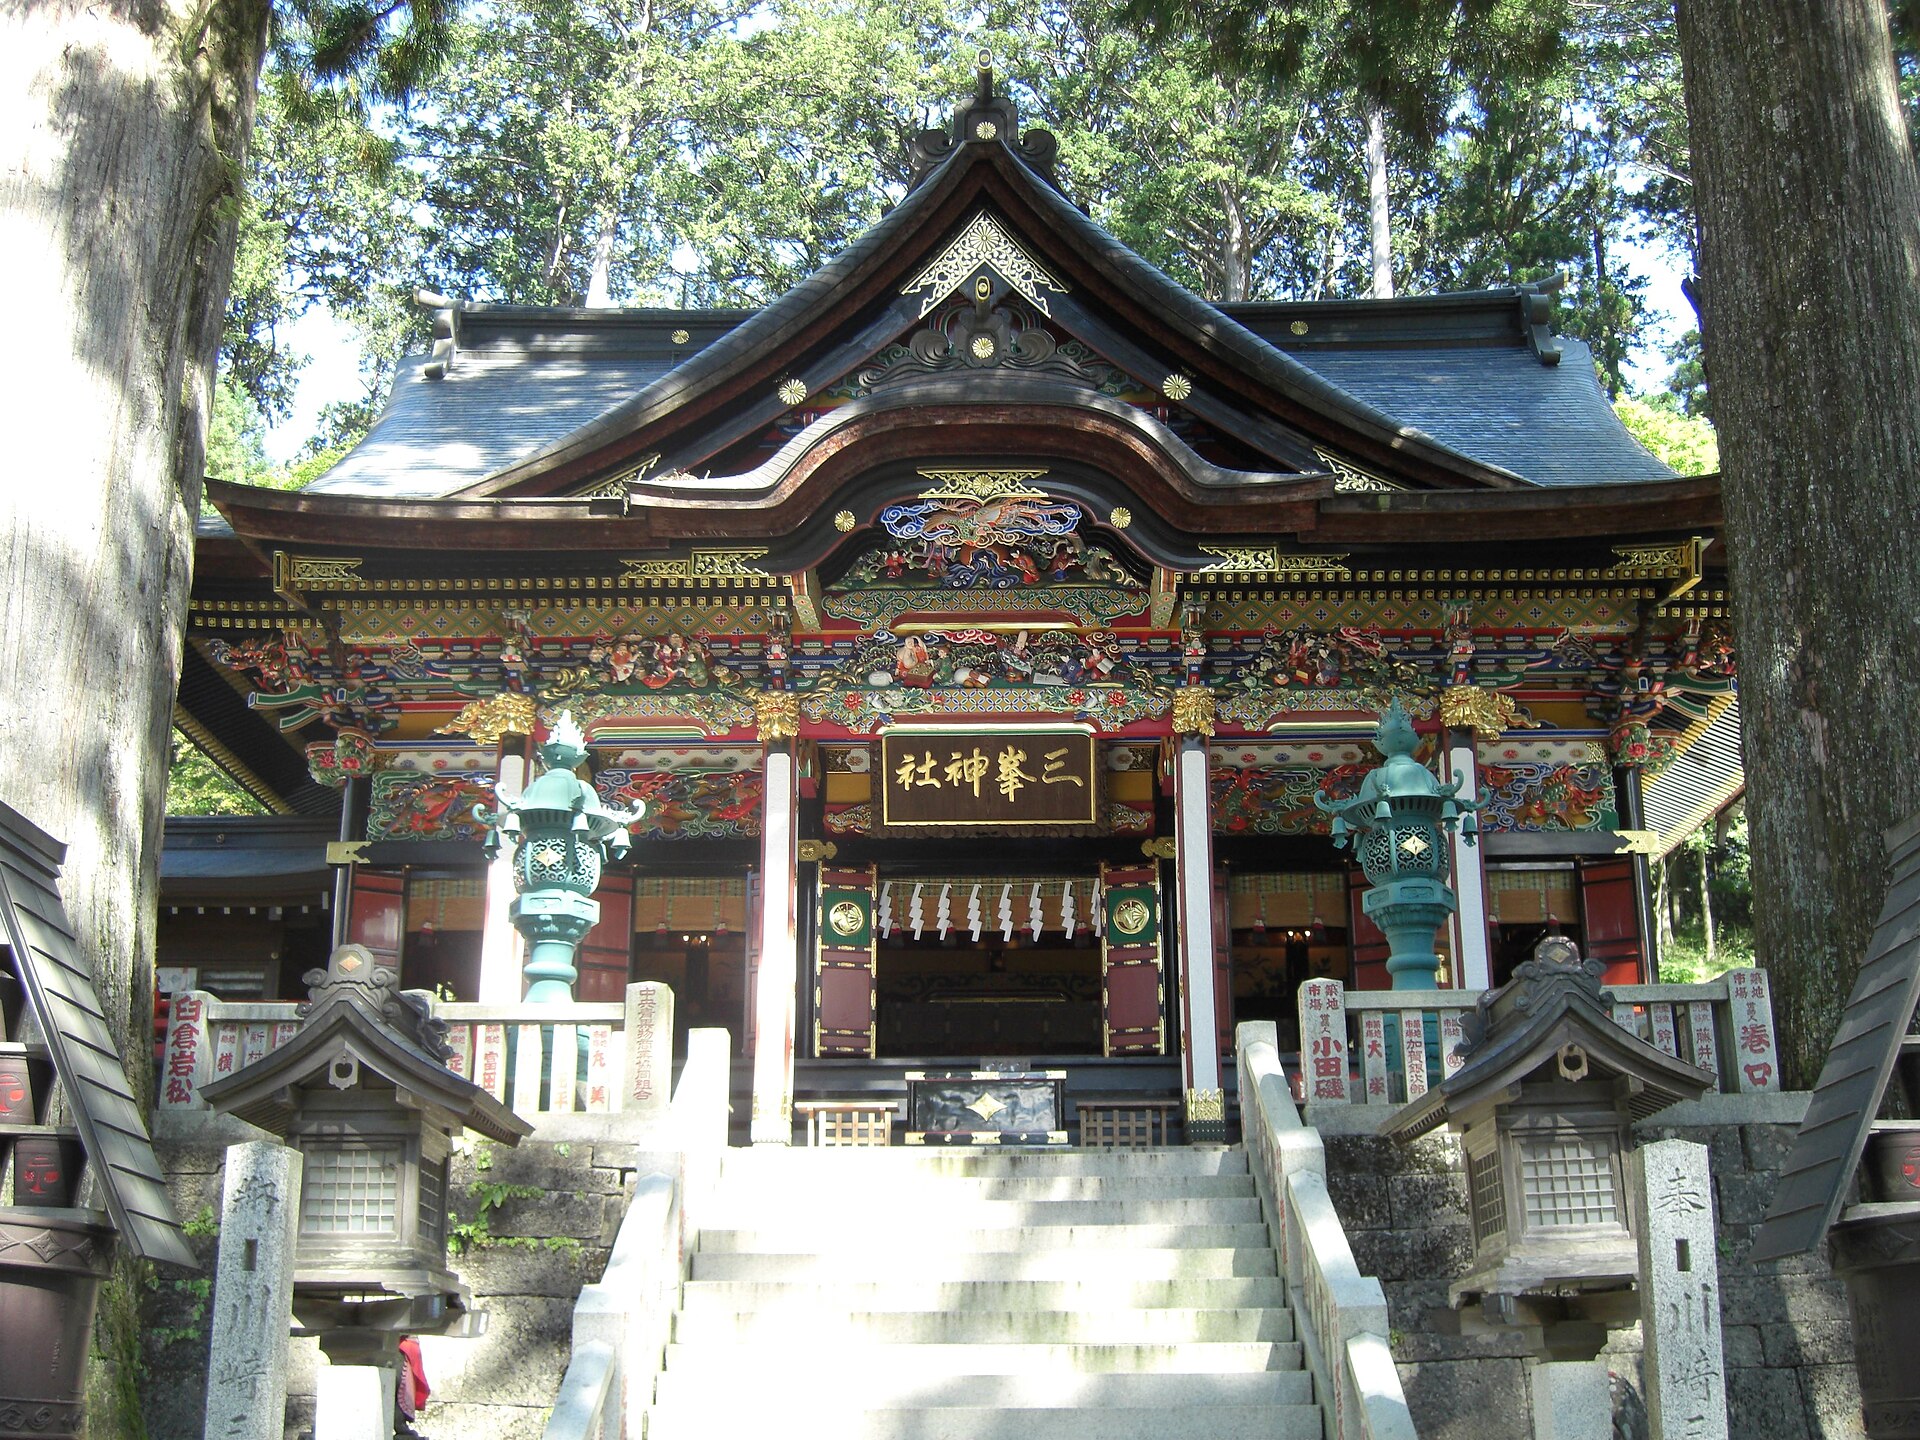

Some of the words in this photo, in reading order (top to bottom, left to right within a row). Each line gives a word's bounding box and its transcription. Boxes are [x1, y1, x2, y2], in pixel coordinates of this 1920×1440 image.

[895, 744, 1084, 803] 三峯神社
[167, 995, 203, 1105] 臼倉岩松
[1313, 1036, 1345, 1099] 小田磯
